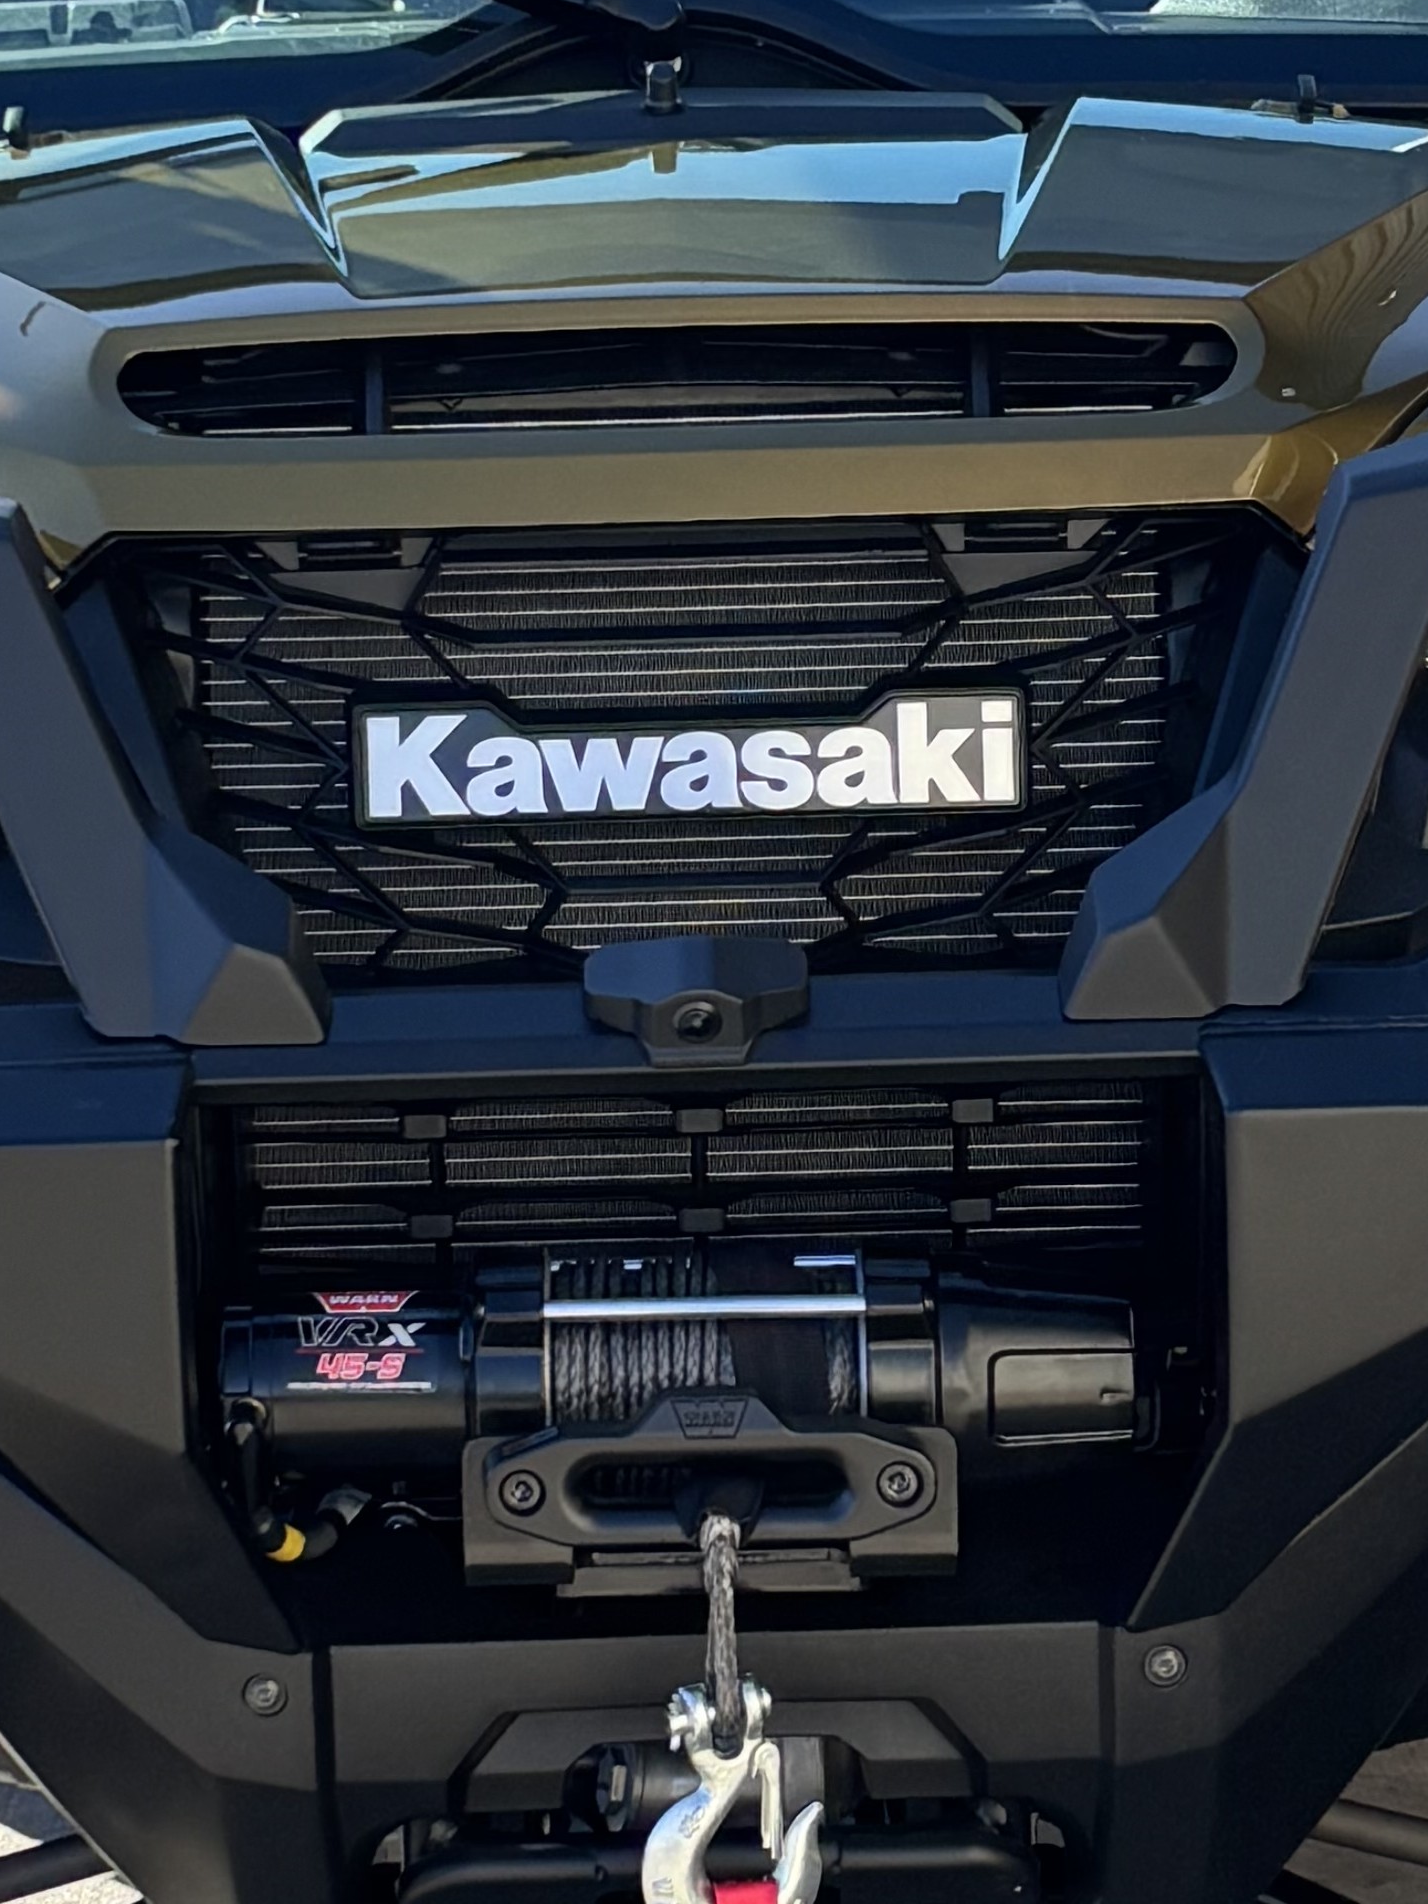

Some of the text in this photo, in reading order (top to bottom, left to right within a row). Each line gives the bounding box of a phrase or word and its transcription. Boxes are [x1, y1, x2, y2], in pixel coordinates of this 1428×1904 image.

[365, 699, 1018, 820] Kawasaki
[329, 1294, 399, 1305] WARN
[316, 1352, 407, 1380] 45-S
